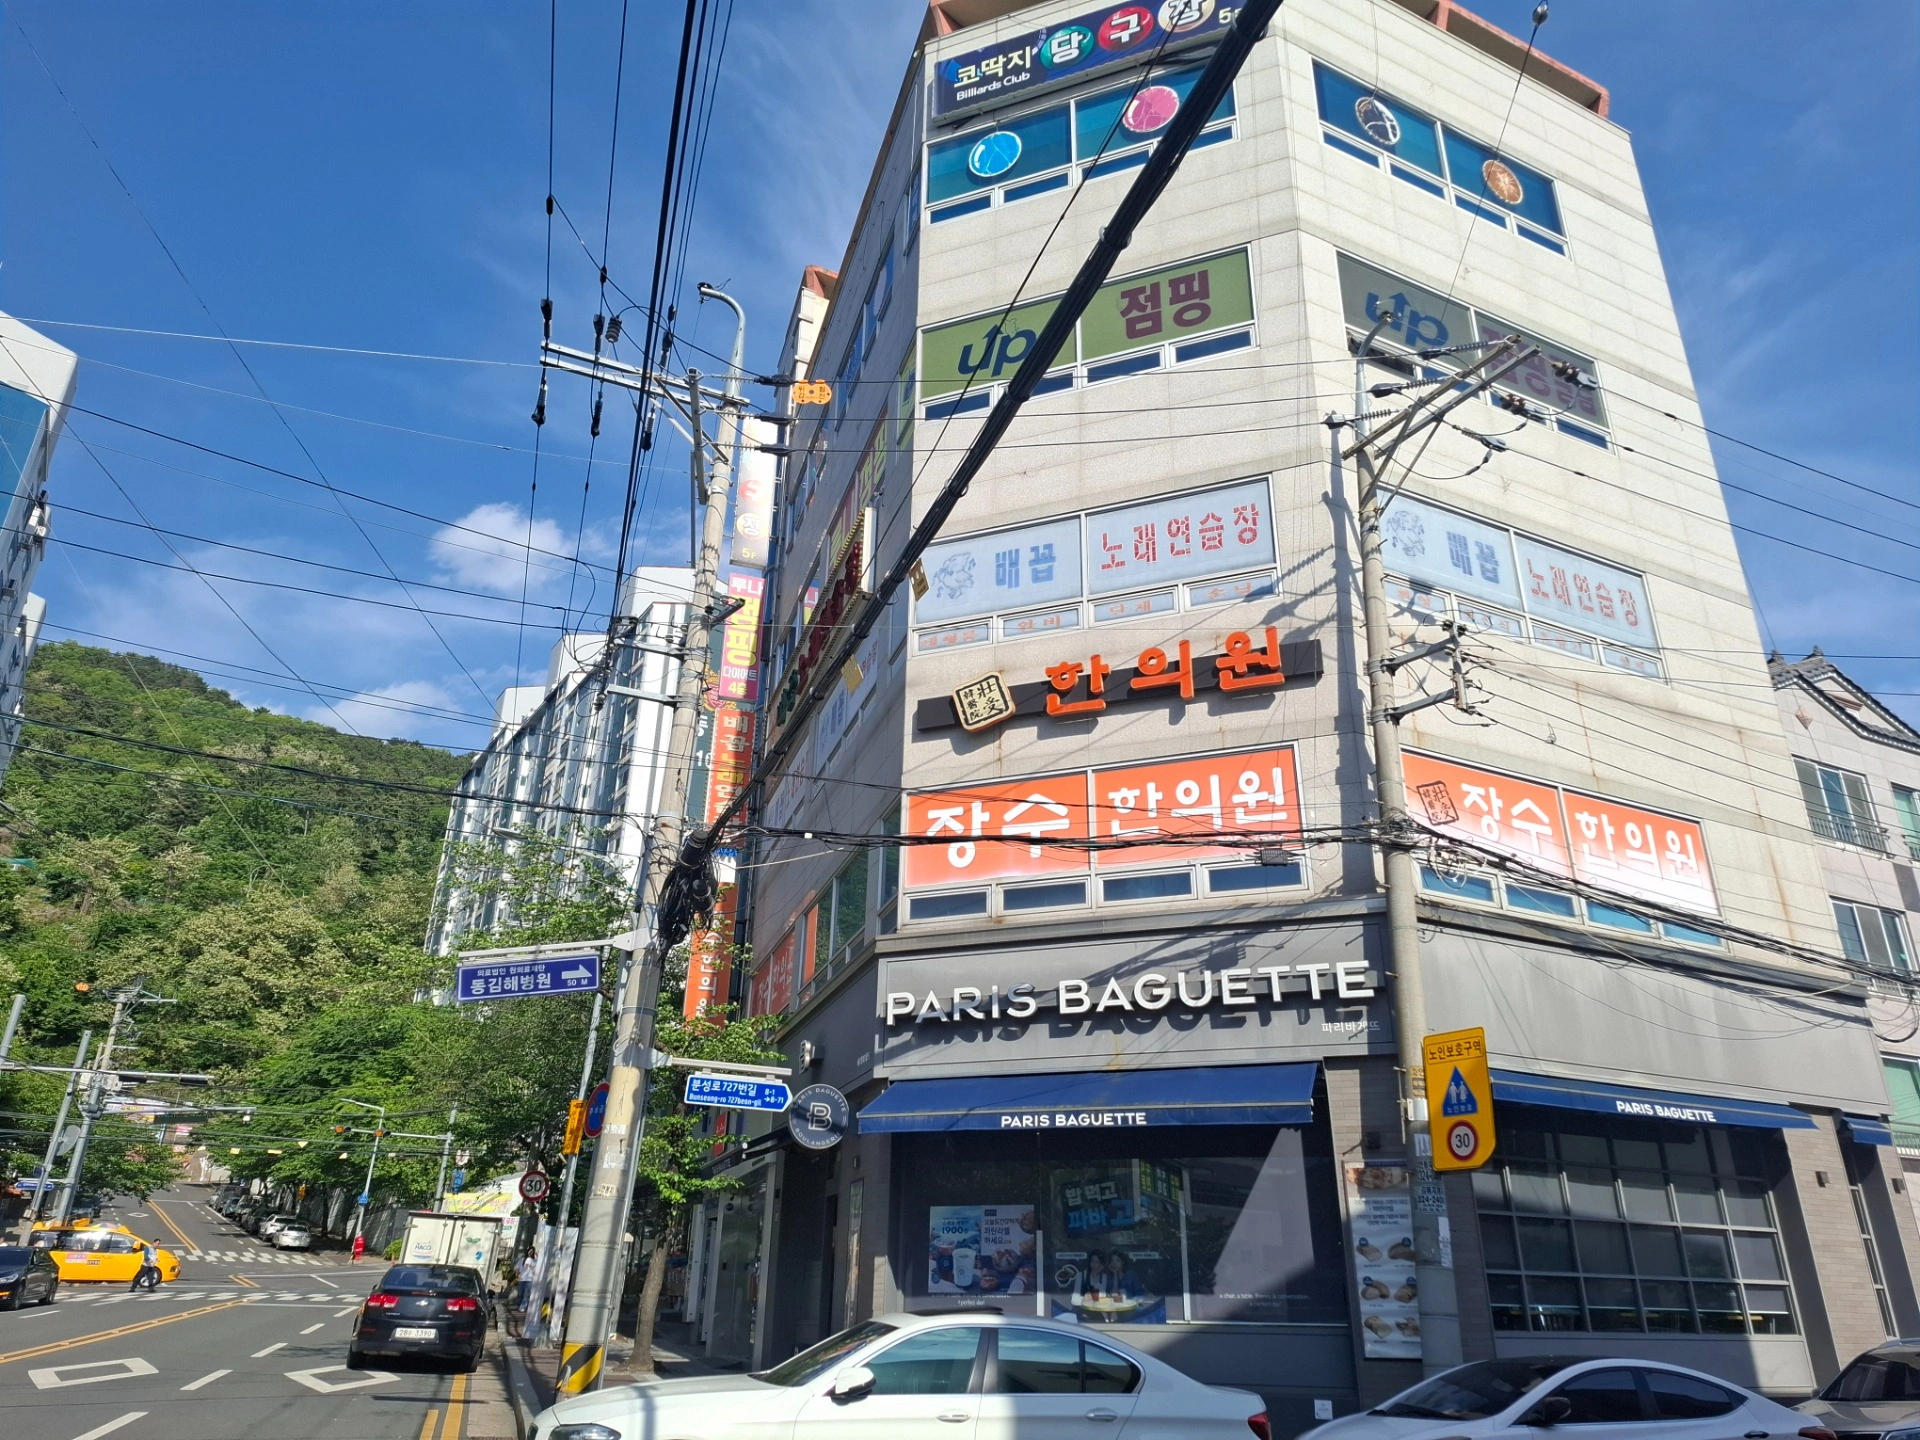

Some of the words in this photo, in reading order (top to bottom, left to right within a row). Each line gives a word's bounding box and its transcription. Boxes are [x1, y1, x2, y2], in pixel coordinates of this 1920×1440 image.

[954, 46, 1031, 88] 코딱지
[1051, 0, 1201, 64] 당구장
[957, 79, 1001, 101] Billiards
[1003, 71, 1031, 87] Club
[1120, 269, 1212, 339] 점핑
[1365, 291, 1449, 347] up
[958, 324, 1038, 378] up
[1101, 503, 1260, 570] 노래연습장
[741, 547, 758, 559] 5F
[1447, 531, 1499, 584] 배꼽
[995, 542, 1056, 589] 배꼽
[731, 576, 764, 596] 루나
[1527, 559, 1638, 627] 노래연습장
[723, 666, 757, 681] 다이어트
[1045, 626, 1285, 717] 한의원
[728, 681, 748, 696] 4층
[720, 715, 750, 753] 배꼽
[927, 793, 1070, 868] 장수
[1108, 767, 1288, 837] 한의원
[1461, 783, 1552, 855] 장수
[1575, 811, 1703, 886] 한의원
[470, 973, 552, 995] 동김해병원
[477, 967, 506, 978] 의료법인
[567, 979, 577, 987] 50
[886, 983, 1036, 1026] PARIS
[1058, 960, 1376, 1014] BAGUETTE
[1321, 1019, 1381, 1034] 파리바게뜨
[1429, 1039, 1482, 1061] 노인보호구역
[815, 1088, 847, 1112] BAGUETTE
[1447, 1103, 1473, 1114] 노인보호
[1616, 1100, 1653, 1116] PARIS
[1656, 1106, 1717, 1123] BAGUETTE
[1001, 1113, 1050, 1128] PARIS
[1055, 1111, 1147, 1127] BAGUETTE
[1455, 1132, 1470, 1149] 30
[526, 1179, 543, 1192] 30
